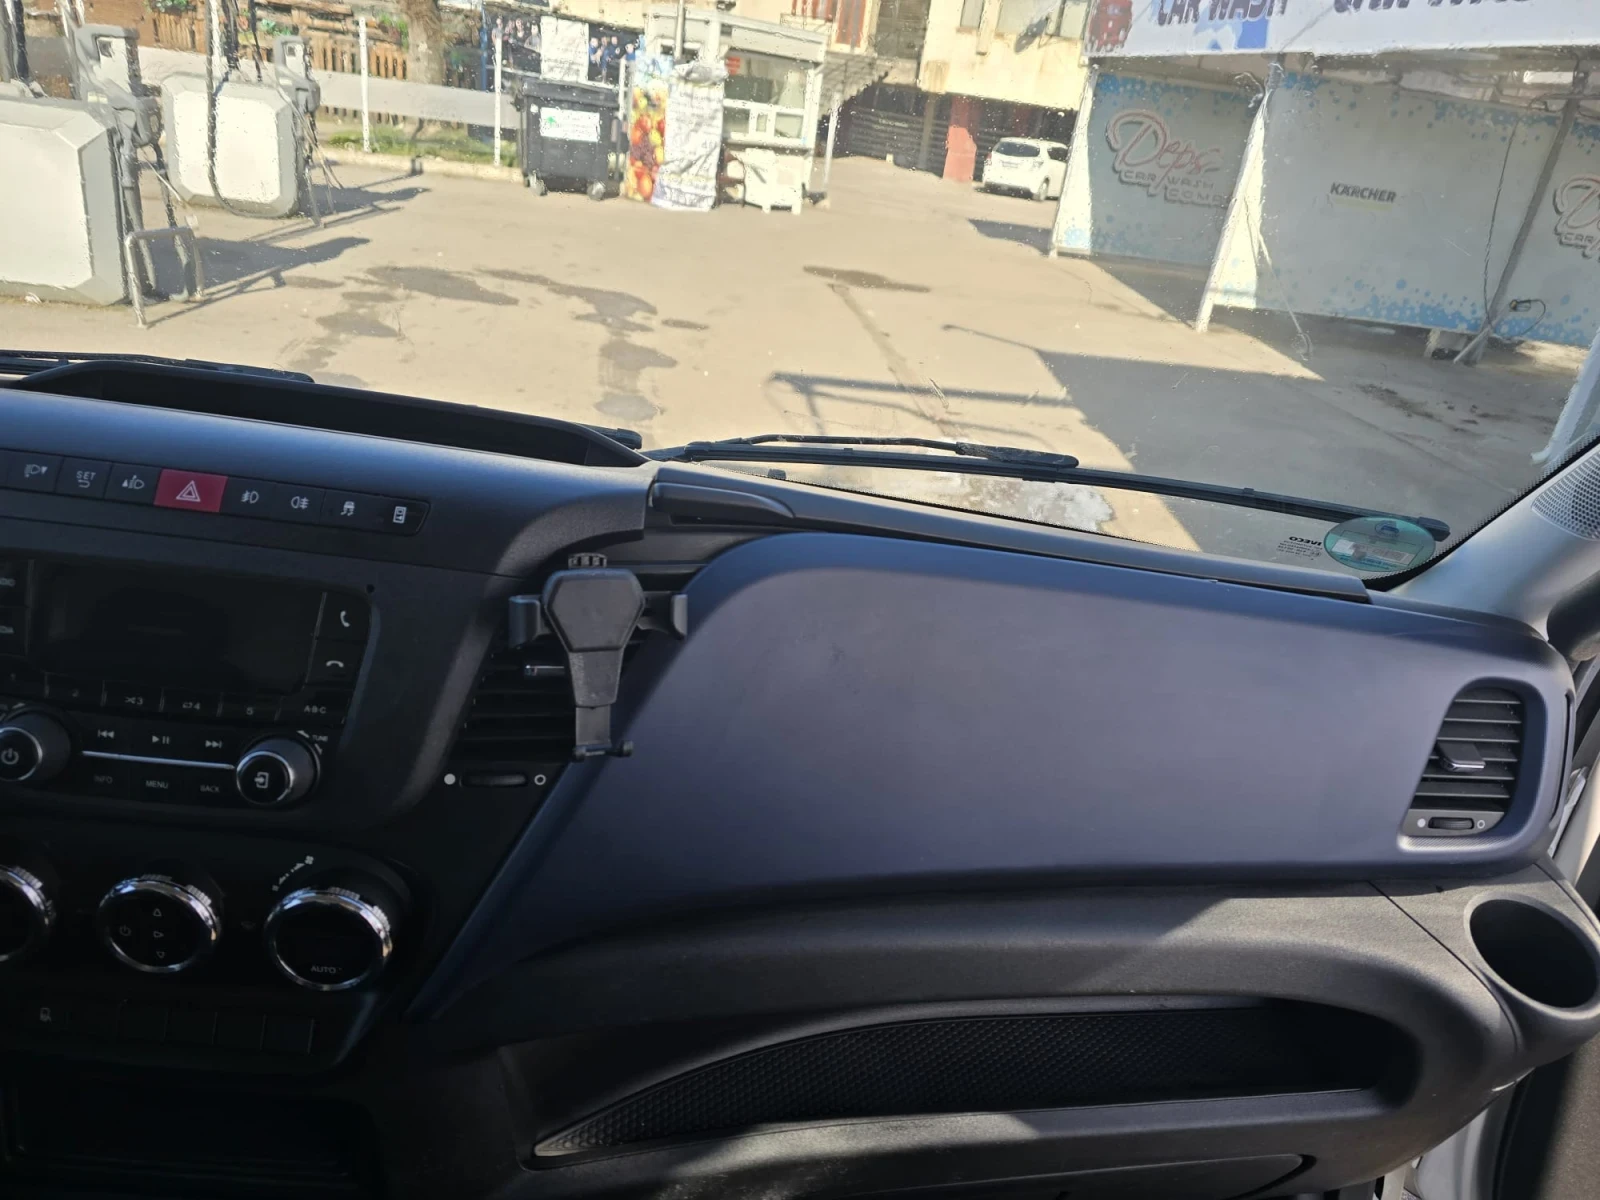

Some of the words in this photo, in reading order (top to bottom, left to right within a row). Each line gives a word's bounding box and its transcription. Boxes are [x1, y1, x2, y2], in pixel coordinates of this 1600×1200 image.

[76, 470, 97, 481] SET
[145, 779, 170, 790] MENU
[199, 784, 221, 794] BACK
[310, 964, 337, 975] AUTO
